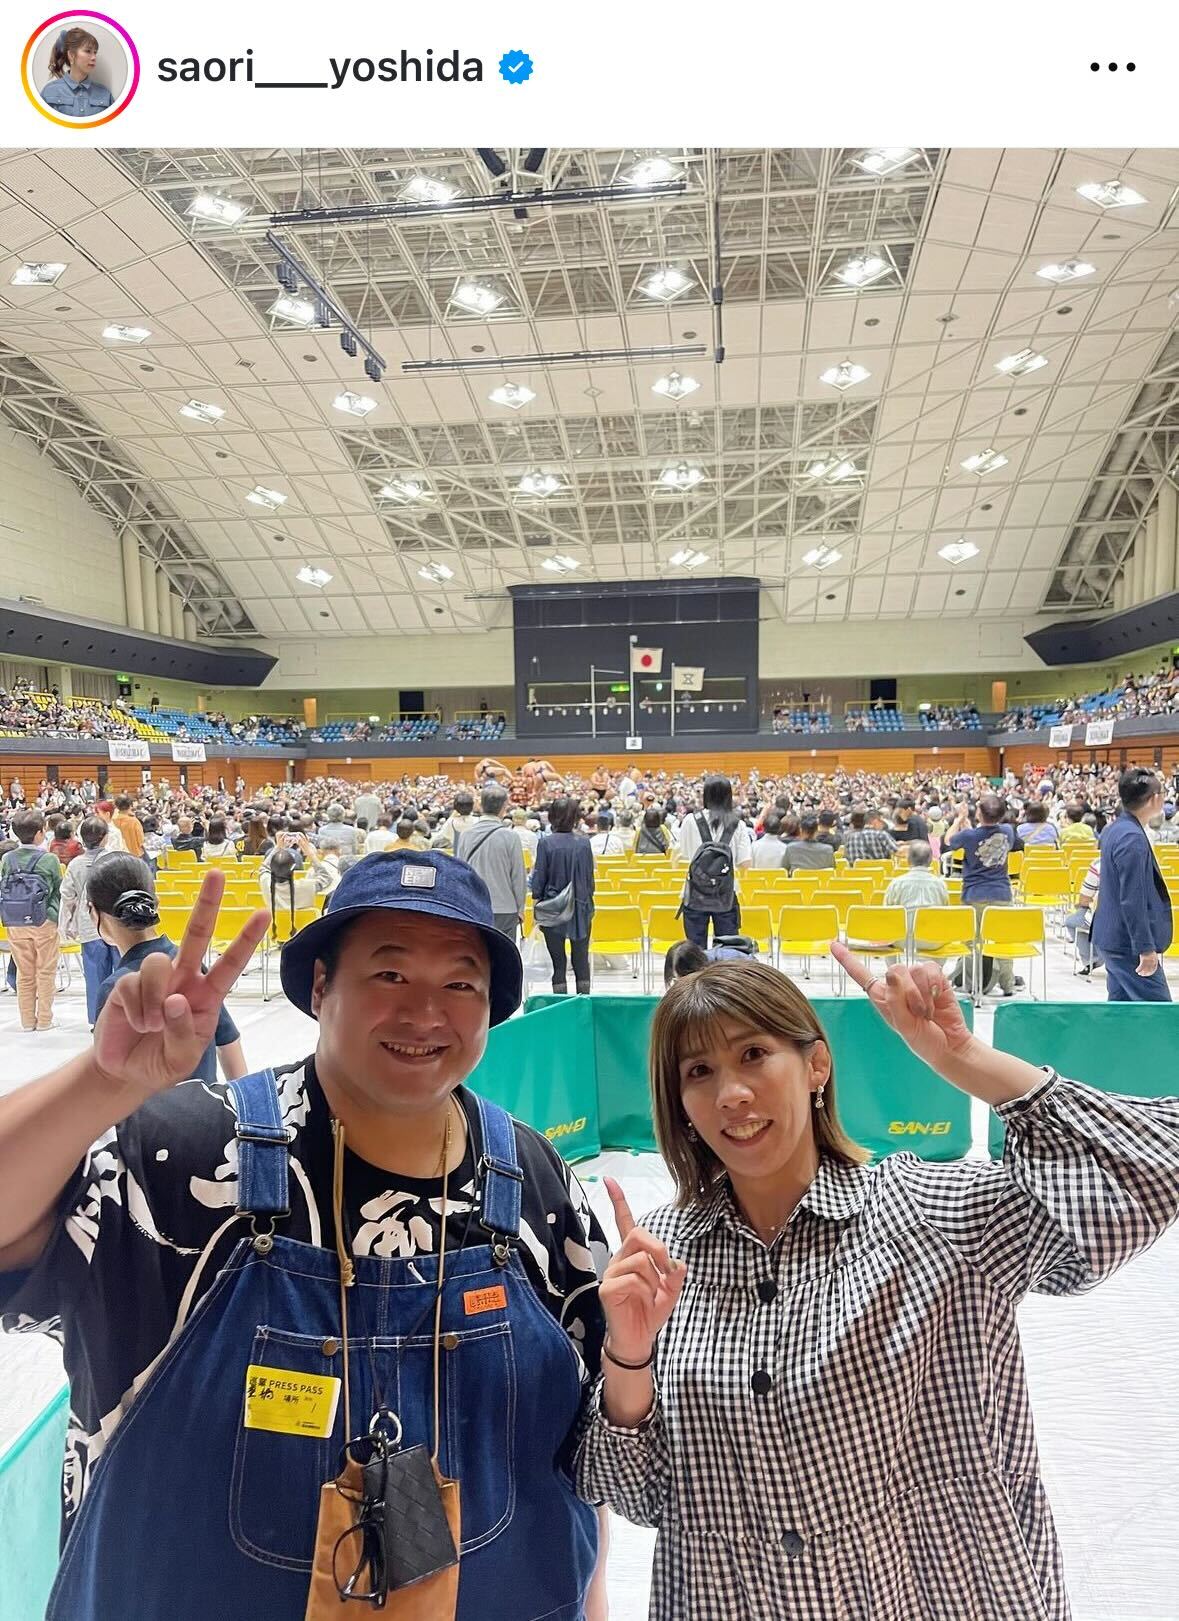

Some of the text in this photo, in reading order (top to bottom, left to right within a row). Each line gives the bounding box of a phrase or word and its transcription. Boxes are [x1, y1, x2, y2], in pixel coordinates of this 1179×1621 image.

[545, 1116, 587, 1140] SAN-EI
[887, 1120, 951, 1135] SAN-EI
[269, 1379, 298, 1392] PRESS
[299, 1384, 323, 1395] PASS
